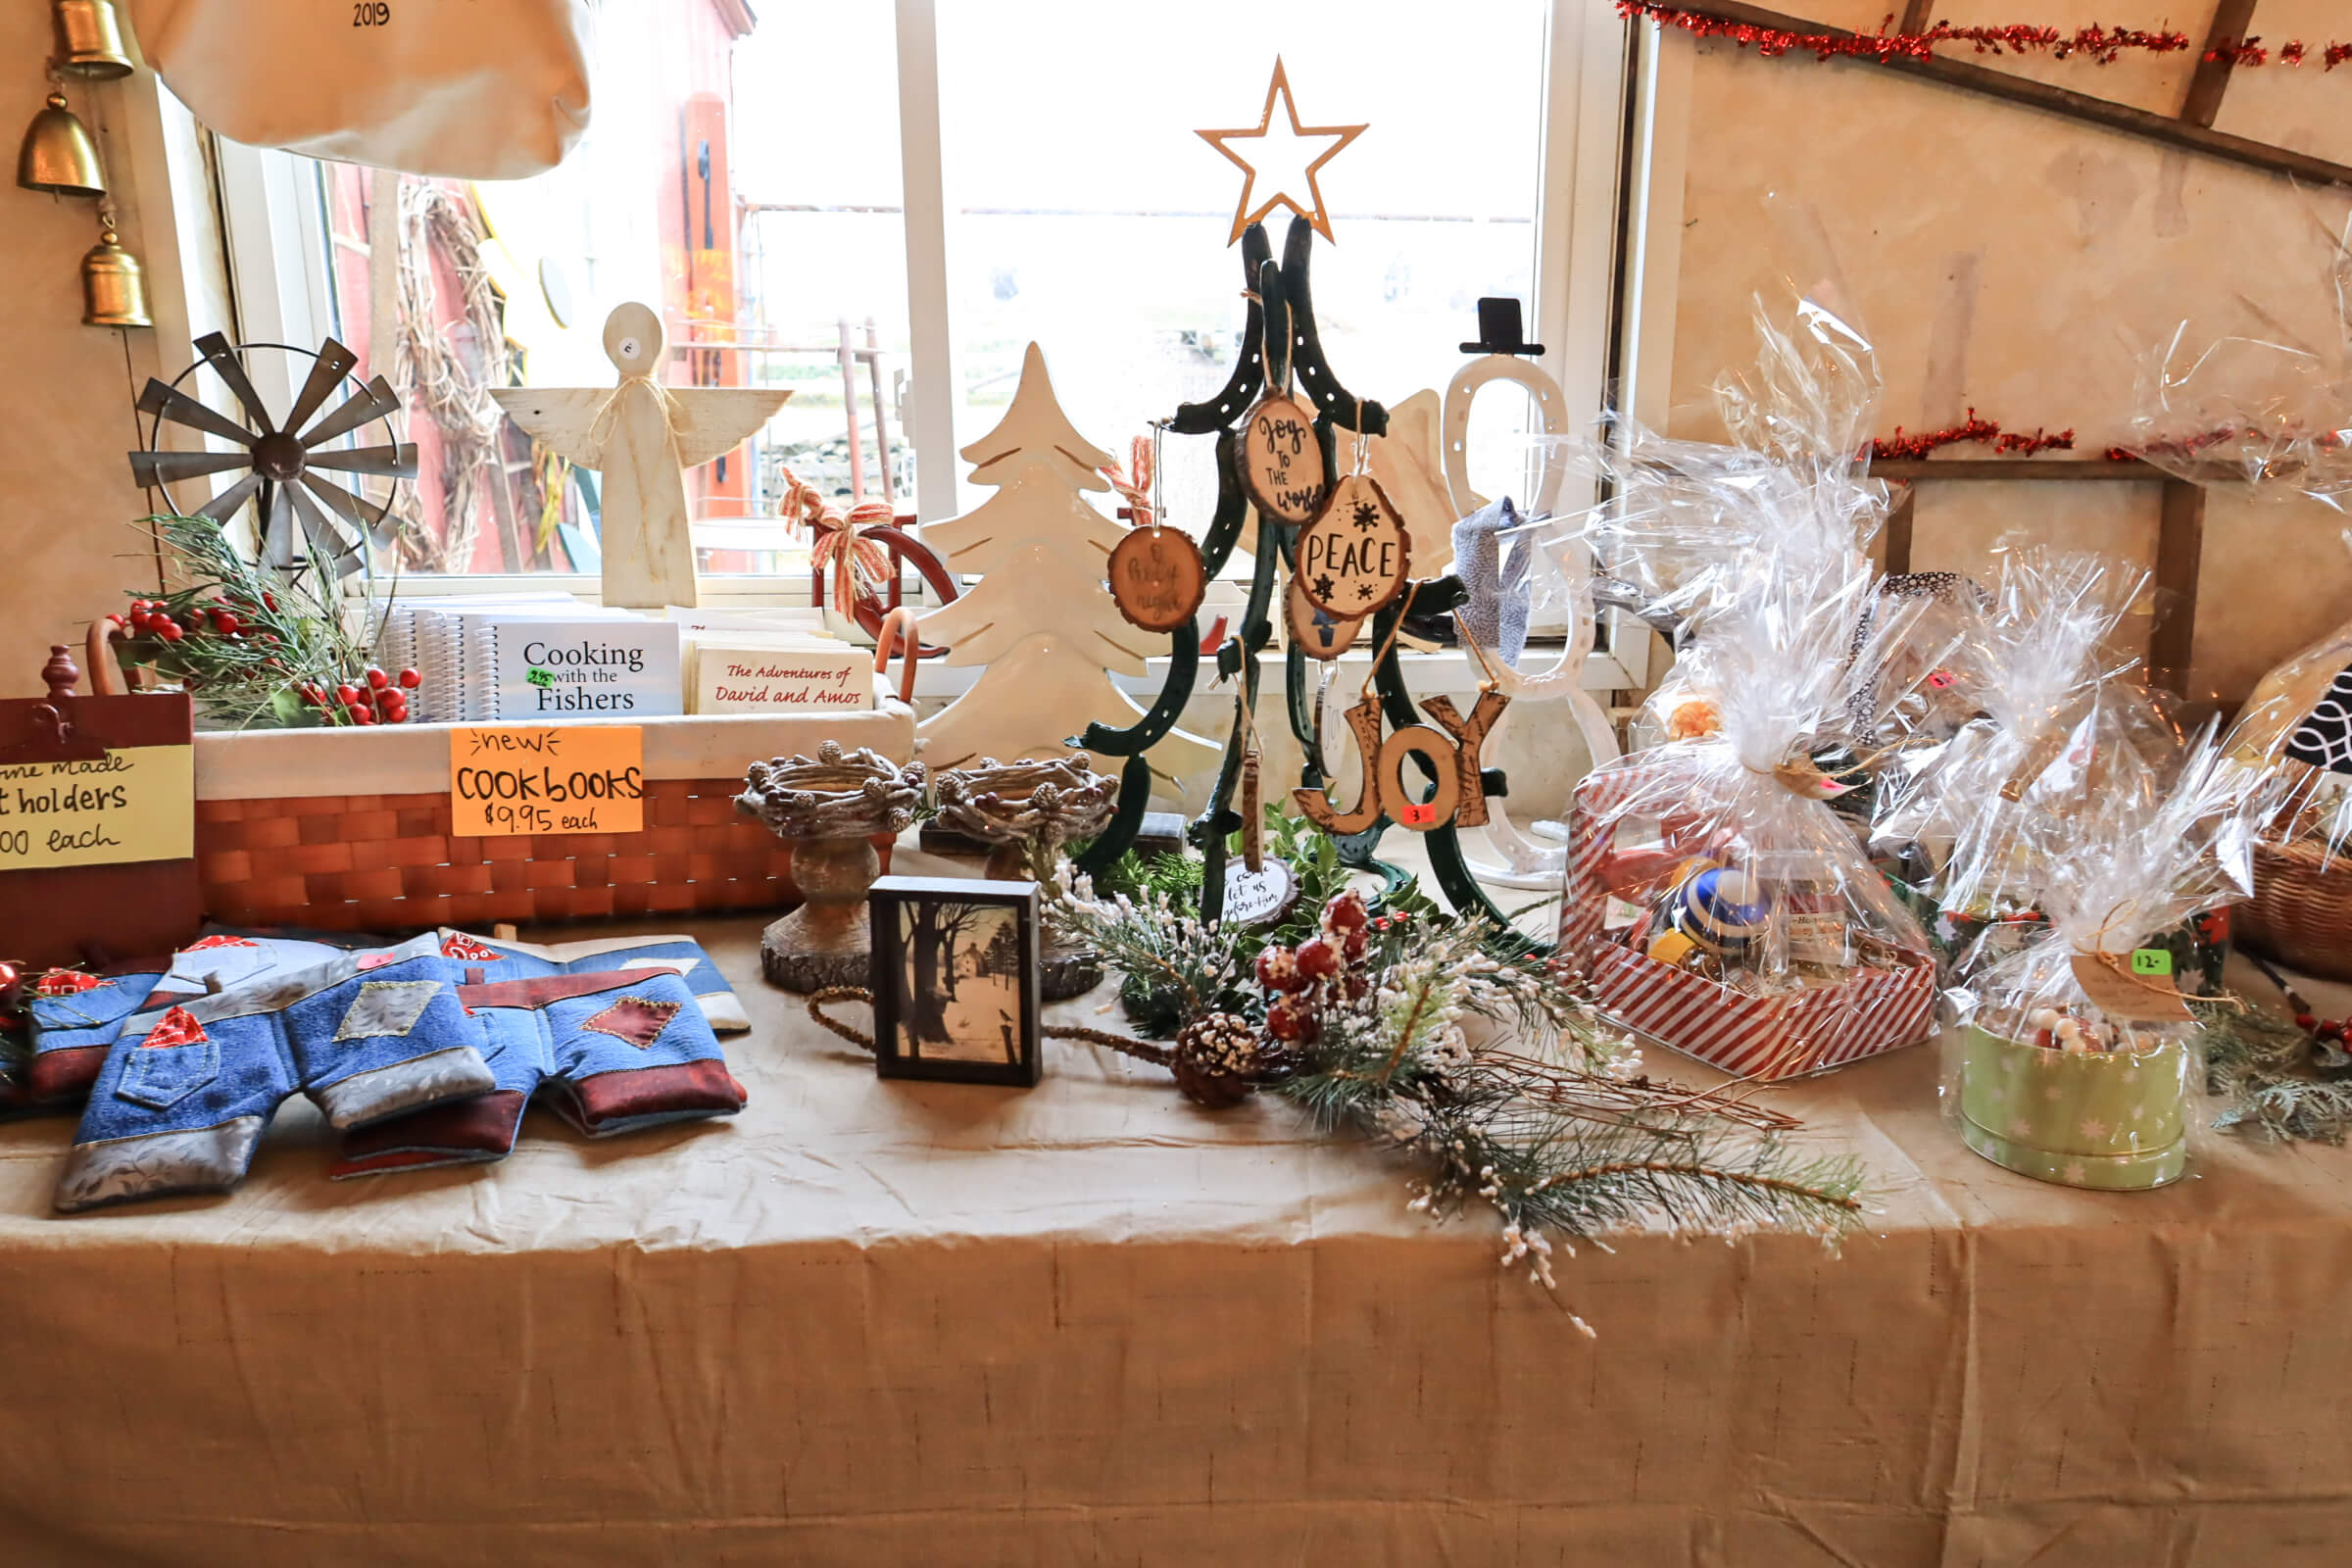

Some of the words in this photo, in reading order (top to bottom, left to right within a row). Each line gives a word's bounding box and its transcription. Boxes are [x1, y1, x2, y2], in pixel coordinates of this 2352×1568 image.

[353, 2, 390, 26] 2019
[1259, 416, 1307, 455] Joy
[1266, 467, 1289, 486] THE
[1306, 532, 1396, 578] PEACE
[523, 641, 644, 672] Cooking
[553, 667, 588, 683] with
[592, 668, 618, 683] the
[727, 664, 752, 678] The
[755, 664, 832, 680] Adventures
[835, 666, 853, 688] of
[536, 686, 635, 711] Fishers
[714, 685, 769, 703] David
[772, 686, 809, 704] and
[813, 689, 862, 705] Amos
[482, 733, 543, 753] new
[1292, 691, 1512, 836] JOY
[18, 783, 127, 814] holders
[485, 802, 553, 834] $9.95
[562, 807, 598, 830] each
[46, 823, 122, 853] each
